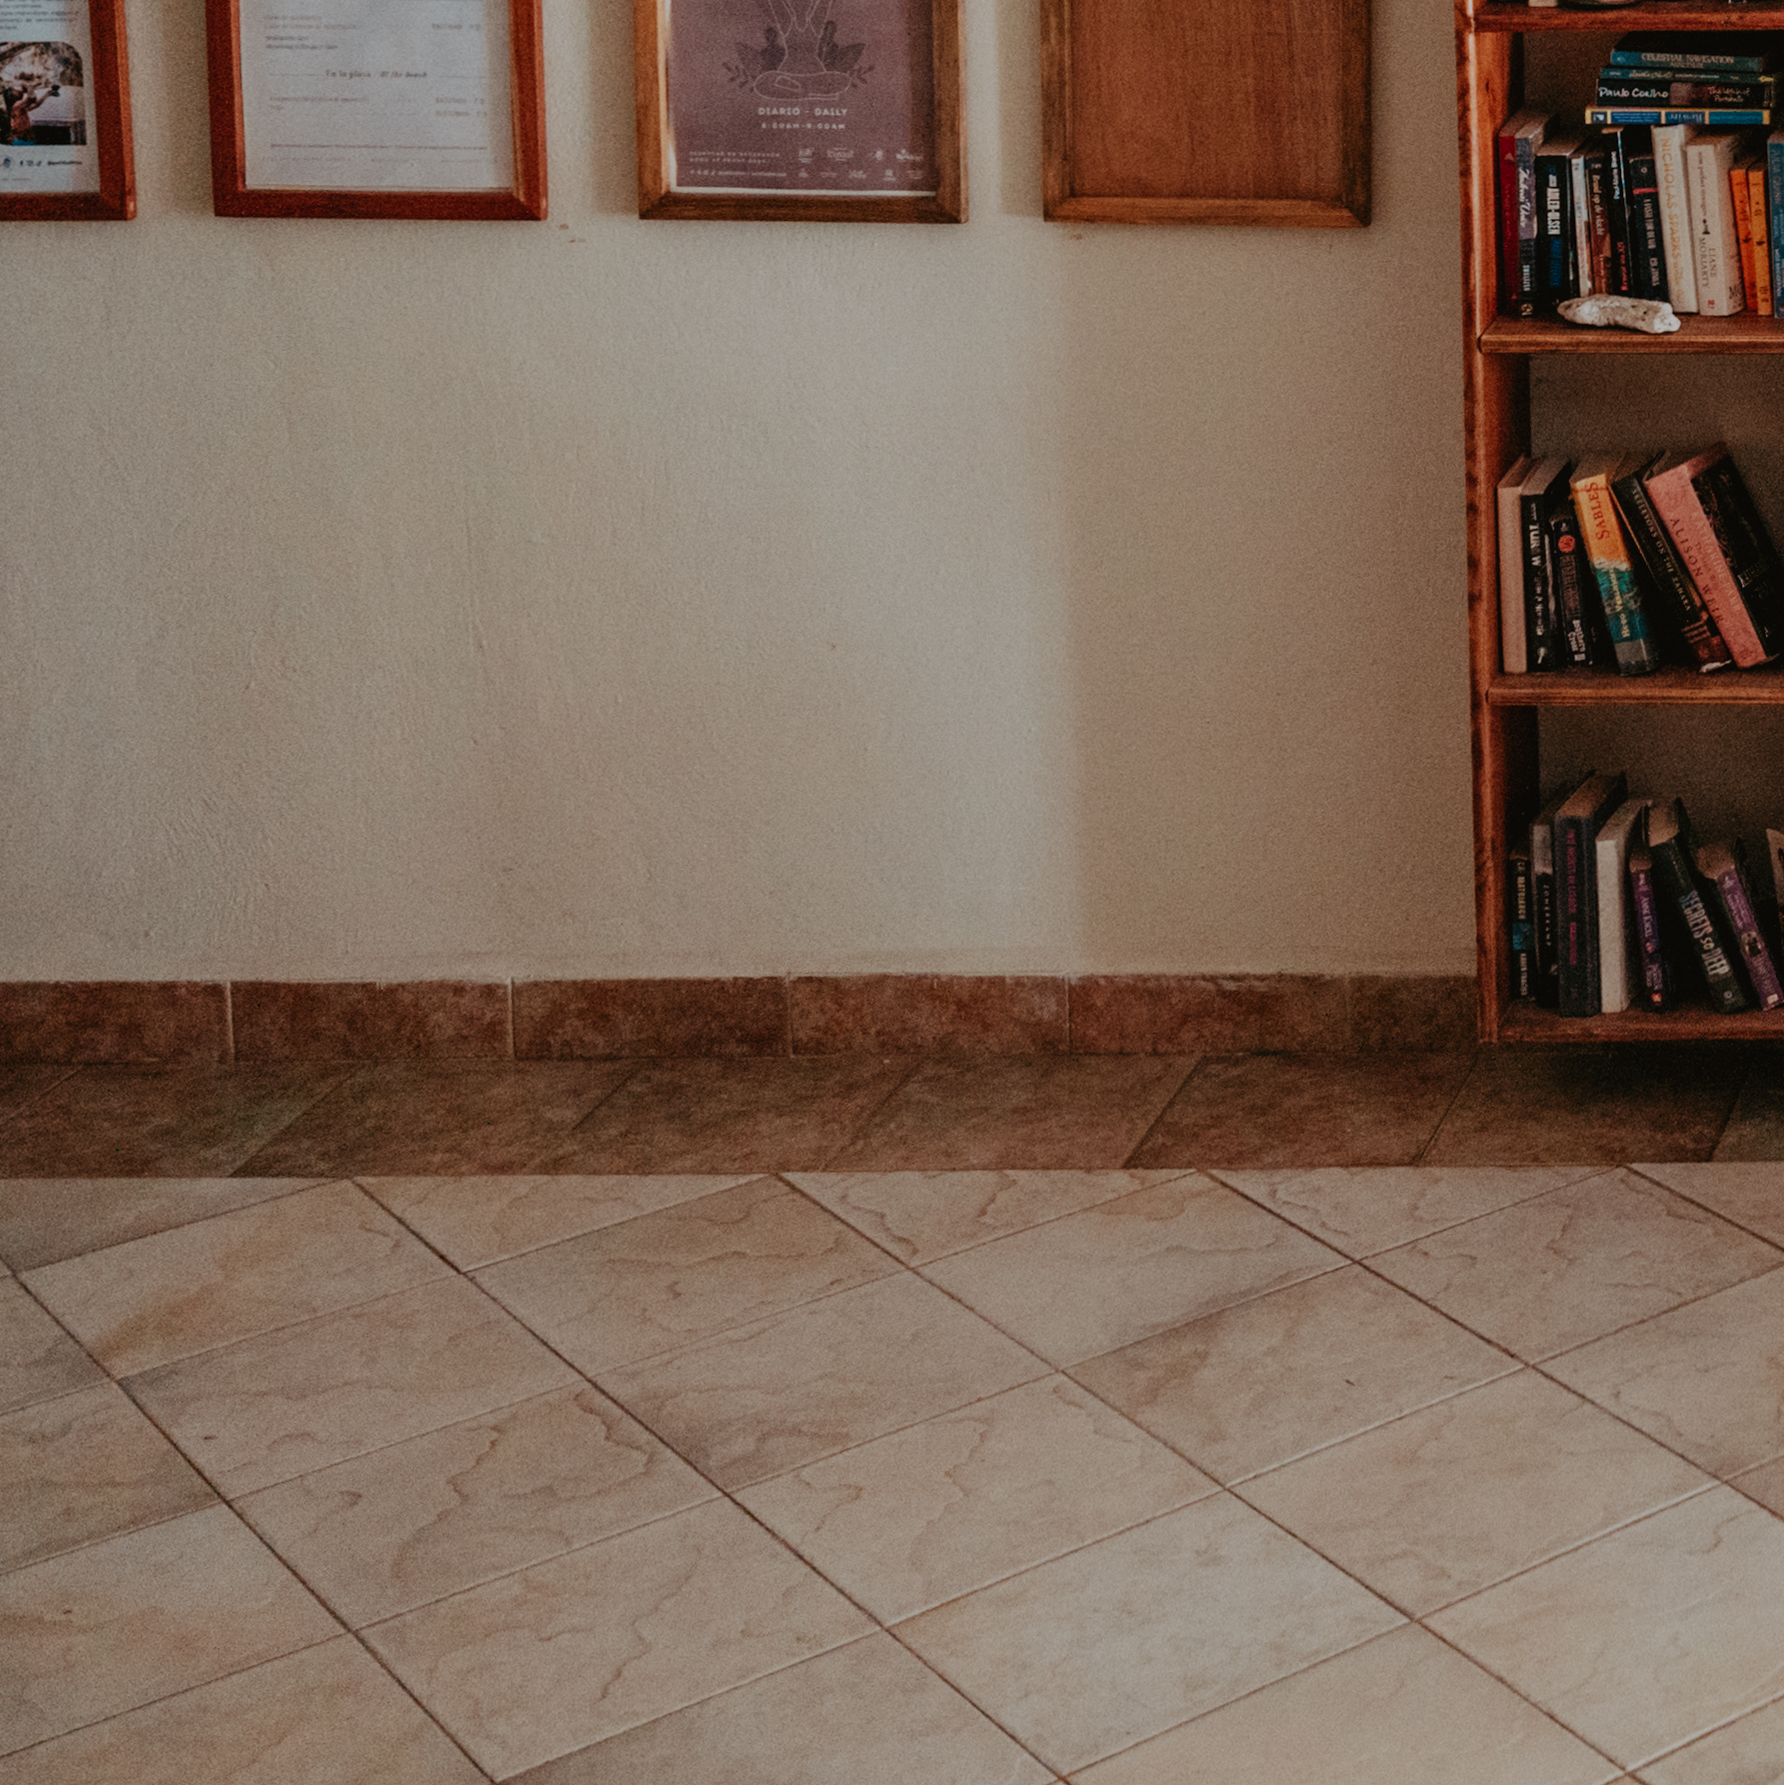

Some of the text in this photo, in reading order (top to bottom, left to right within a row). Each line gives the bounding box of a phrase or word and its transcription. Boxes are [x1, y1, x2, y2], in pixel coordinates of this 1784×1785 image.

[1641, 53, 1735, 65] CELESTIAL NAVIGATION
[814, 108, 848, 117] DAILY
[1598, 87, 1669, 99] Paulo Coelho
[1547, 187, 1561, 235] ADLER-OLSEN
[1659, 136, 1681, 266] NICHOLAS SPARKS
[1700, 237, 1709, 288] MORIARTY
[1708, 248, 1717, 279] LIANE
[1587, 481, 1611, 541] SABLES
[1661, 555, 1673, 575] THE
[1668, 516, 1726, 625] ALISON WEIR
[1679, 889, 1730, 977] SECRETS DEEP
